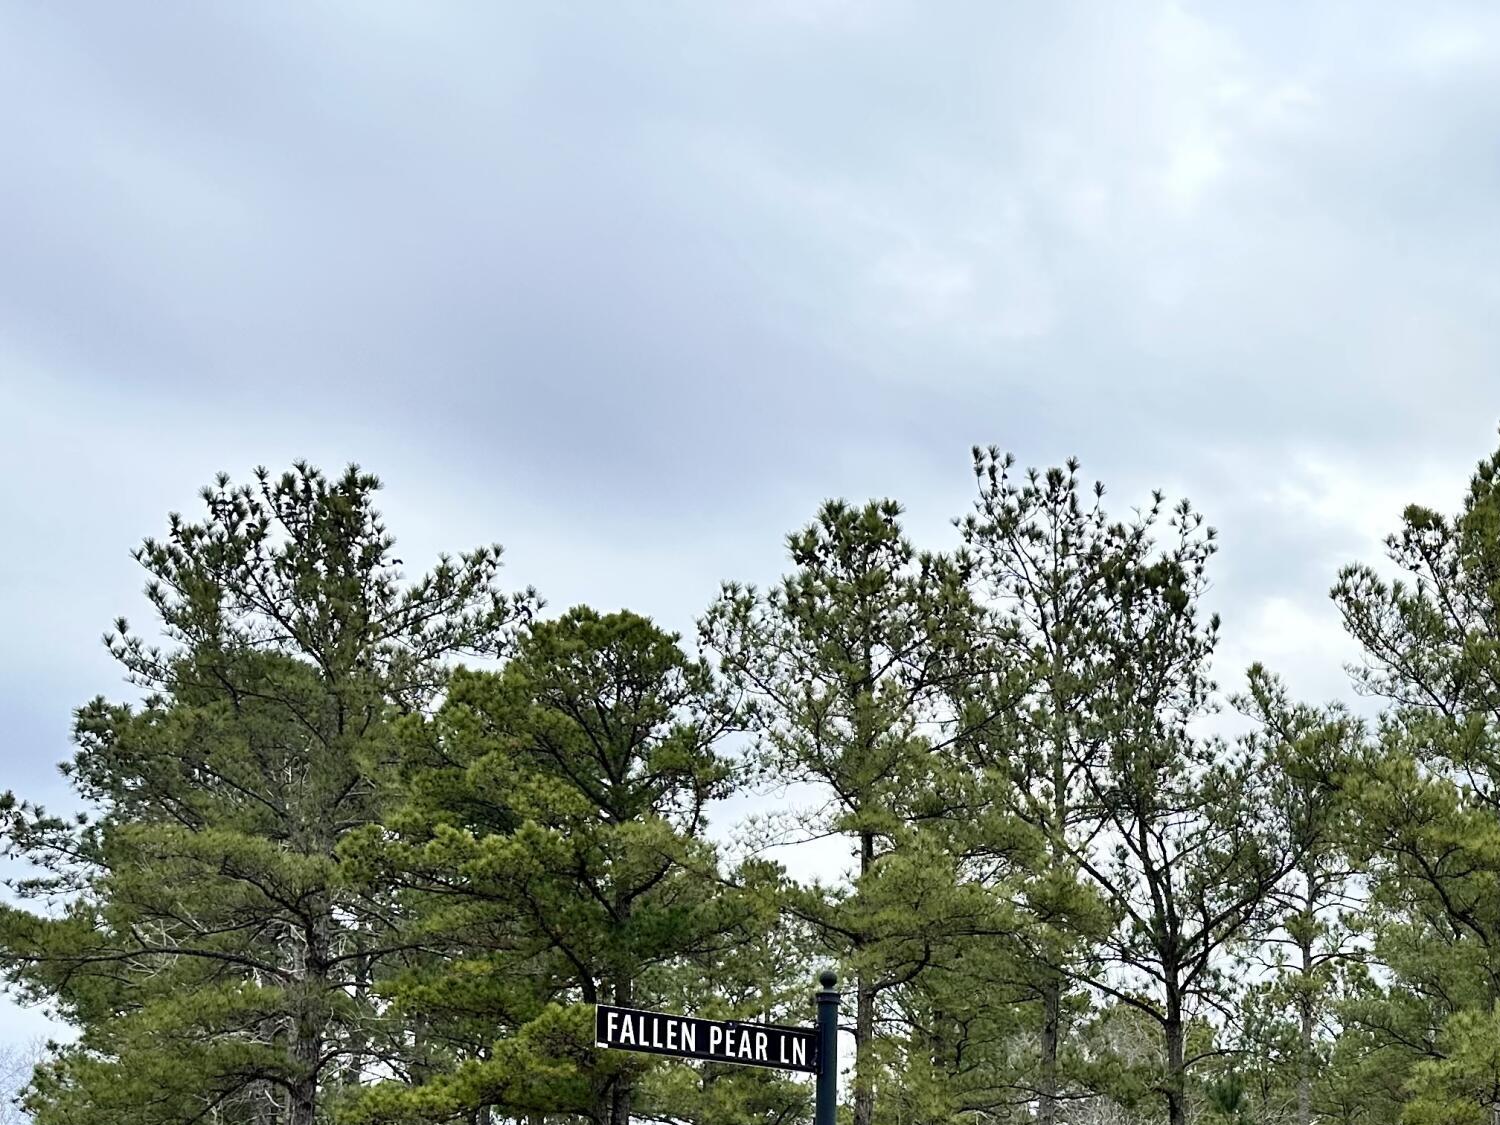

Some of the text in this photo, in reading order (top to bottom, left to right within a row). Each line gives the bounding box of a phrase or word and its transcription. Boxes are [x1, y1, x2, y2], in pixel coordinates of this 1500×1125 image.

[606, 1012, 806, 1066] FALLEN PEAR LN
